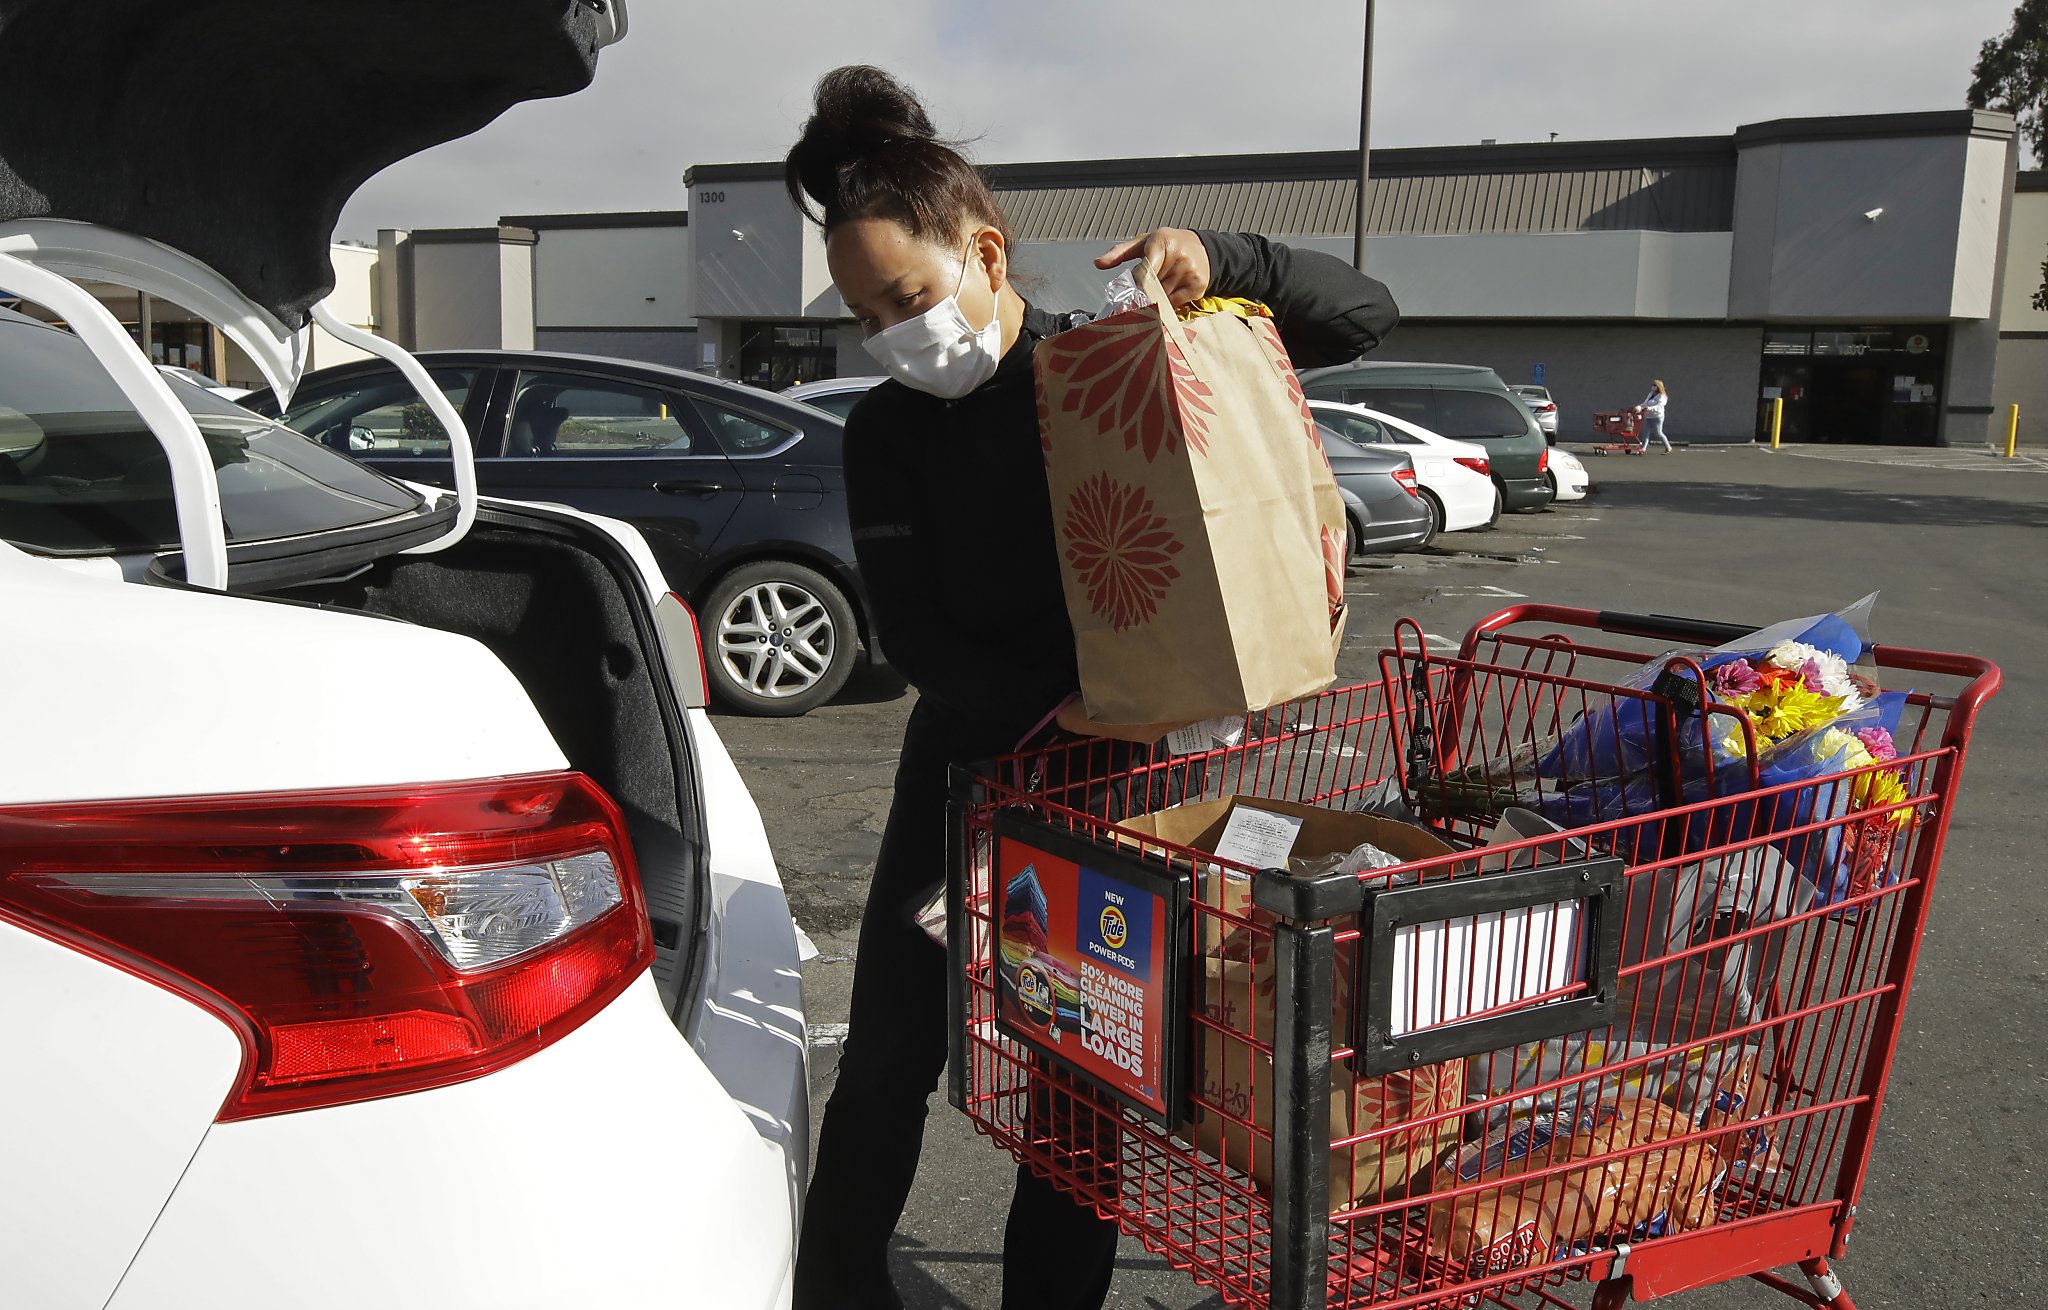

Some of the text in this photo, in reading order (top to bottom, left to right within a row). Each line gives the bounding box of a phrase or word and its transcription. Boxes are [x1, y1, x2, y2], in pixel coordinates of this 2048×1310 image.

[700, 191, 725, 203] 1300
[1105, 890, 1125, 906] NEW
[1102, 914, 1125, 938] Tide
[1089, 941, 1135, 970] POWER PODS
[1080, 961, 1144, 1002] 50% MORE
[1080, 976, 1143, 1018] CLEANING
[1080, 990, 1127, 1026] POWER
[1129, 1014, 1143, 1034] IN
[1080, 1005, 1143, 1056] LARGE
[1080, 1026, 1144, 1078] LOADS
